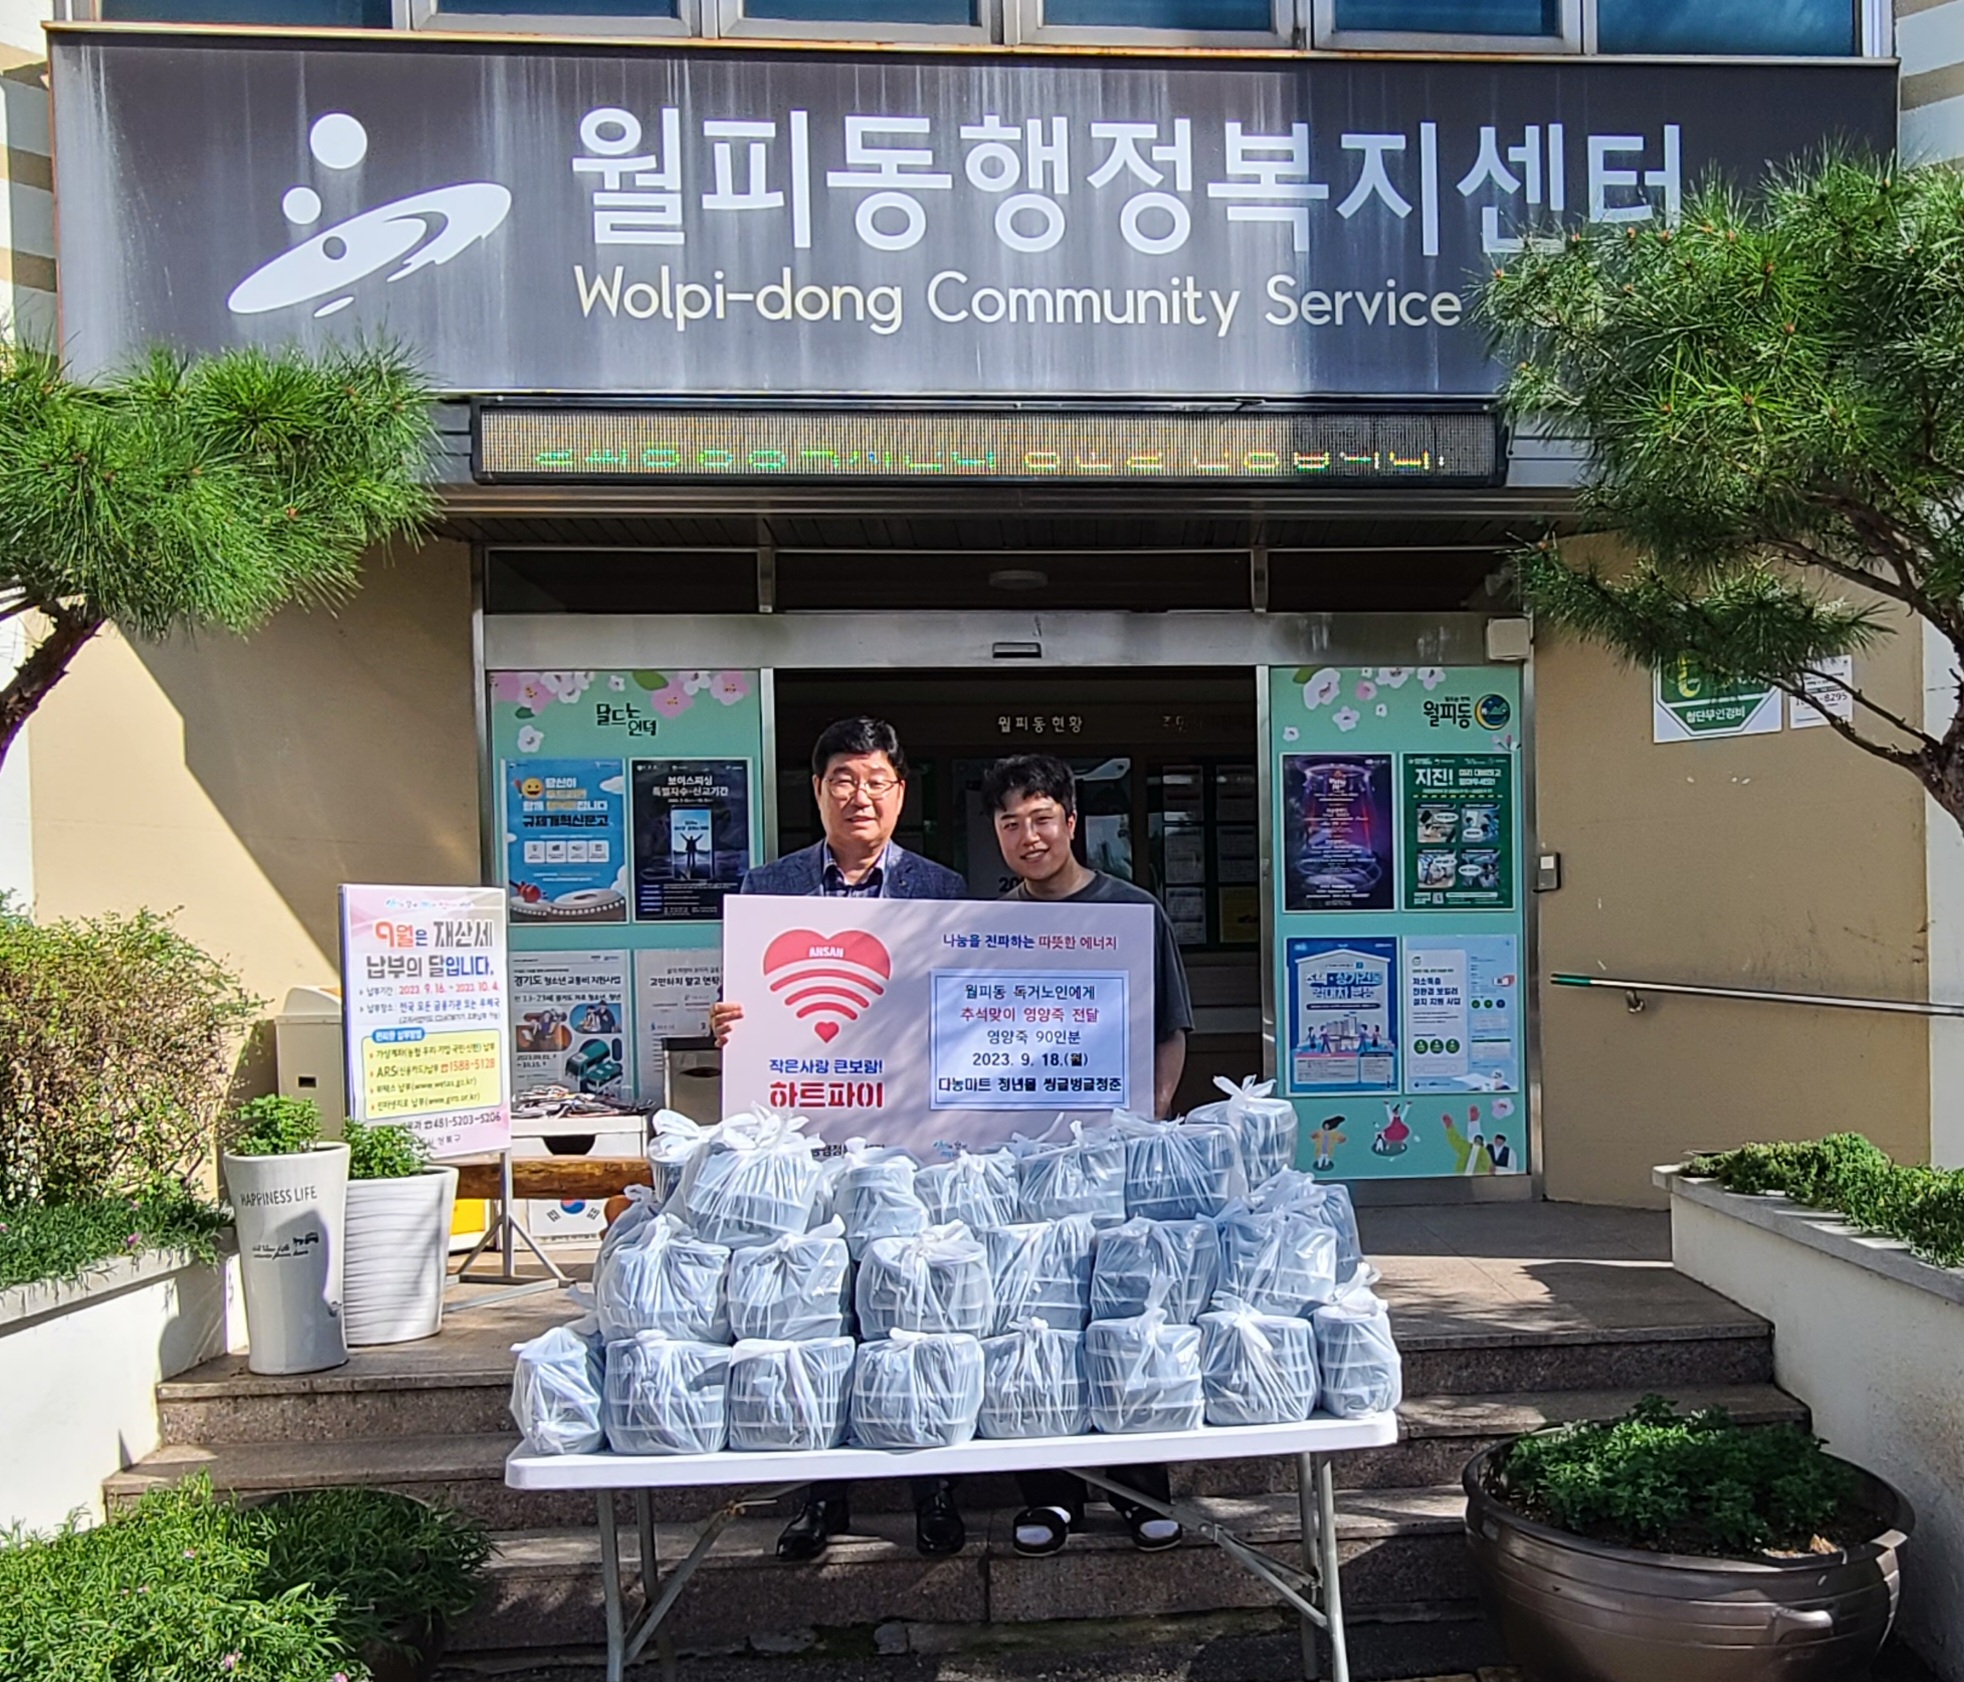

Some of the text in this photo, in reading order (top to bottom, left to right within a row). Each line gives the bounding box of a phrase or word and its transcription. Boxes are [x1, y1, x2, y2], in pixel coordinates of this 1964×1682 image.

[572, 107, 1682, 256] 월피동행정복지센터
[574, 265, 1462, 337] Wolpi-dong Community Service
[1423, 700, 1472, 729] 월피동
[628, 720, 657, 737] 언덕
[999, 716, 1082, 733] 월피동 현황
[667, 775, 713, 786] 보이스피싱
[1415, 768, 1453, 787] 지진!
[522, 814, 610, 828] 규제개혁신문고
[375, 921, 493, 948] 9월은 재산세
[943, 933, 1118, 950] 나눔을 전파하는 따뜻한 에너지
[808, 946, 844, 958] ANSAN
[366, 955, 494, 979] 납부의 달입니다.
[513, 974, 621, 987] 경기도 청소년 교통비 지원사업
[650, 977, 684, 987] 고민하지
[685, 976, 701, 987] 말고
[366, 986, 393, 997] 납부기간
[965, 984, 1095, 1000] 월피동 독거노인에게
[400, 1001, 415, 1013] 전국
[434, 999, 462, 1012] 금융기관
[960, 1006, 1099, 1023] 추석맞이 영양죽 전달
[987, 1029, 1081, 1045] 영양죽 90인분
[769, 1059, 883, 1074] 작은사랑 큰보람!
[972, 1052, 1089, 1067] 2023. 9. 18.(월)
[938, 1077, 992, 1091] 다농마트
[997, 1077, 1036, 1092] 청년몰
[769, 1081, 883, 1108] 하트파이
[240, 1185, 318, 1207] HAPPINESS LIFE
